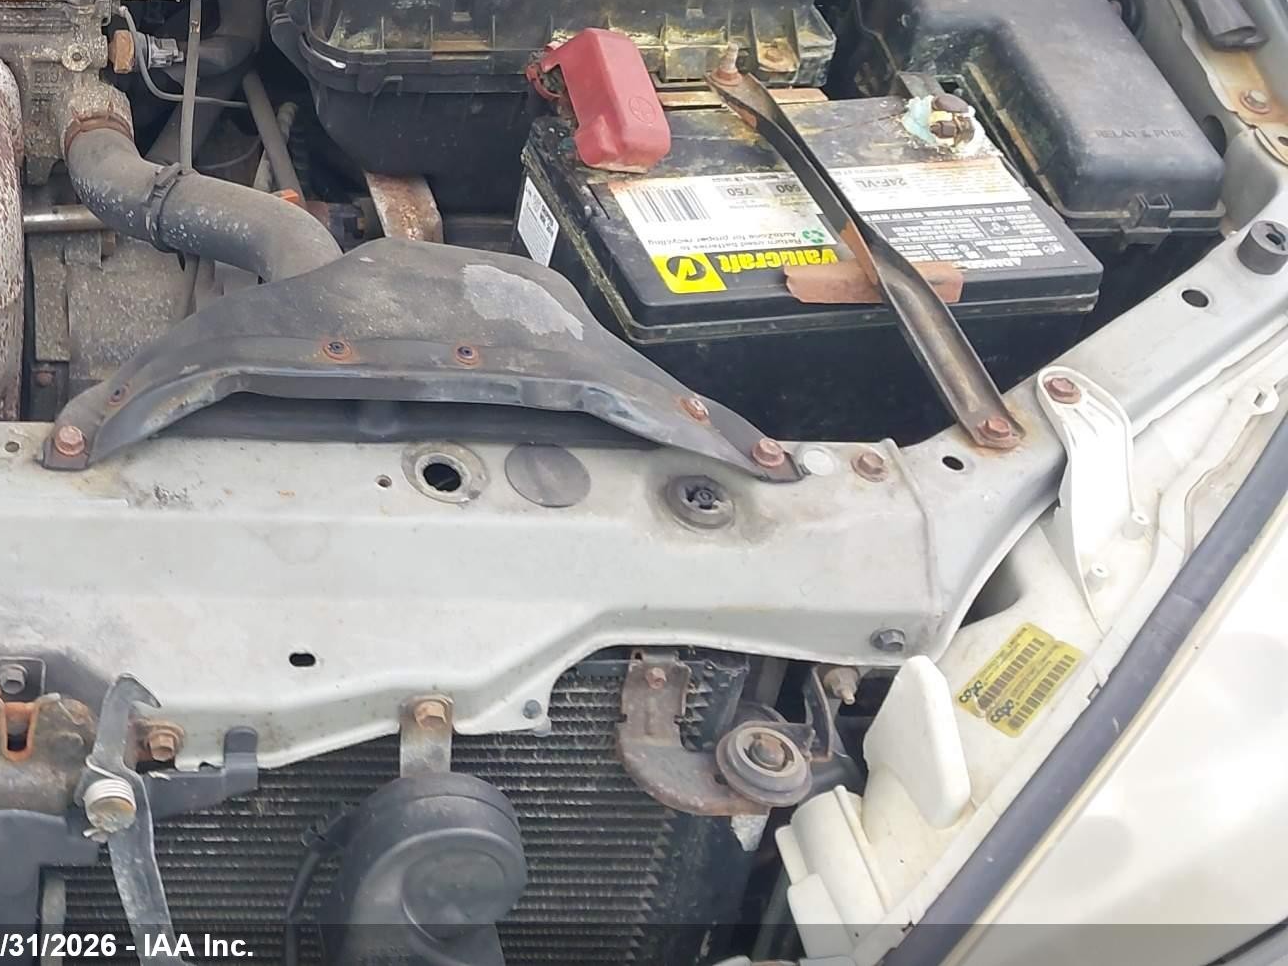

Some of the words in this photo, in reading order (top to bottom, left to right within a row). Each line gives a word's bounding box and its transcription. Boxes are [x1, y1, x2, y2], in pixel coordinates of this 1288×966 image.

[726, 187, 753, 196] 750
[696, 234, 729, 243] proper
[732, 234, 746, 242] for
[748, 231, 797, 240] AutoZone
[647, 237, 694, 246] recycling
[740, 239, 765, 247] used
[768, 238, 802, 246] Return
[693, 242, 738, 250] batteries
